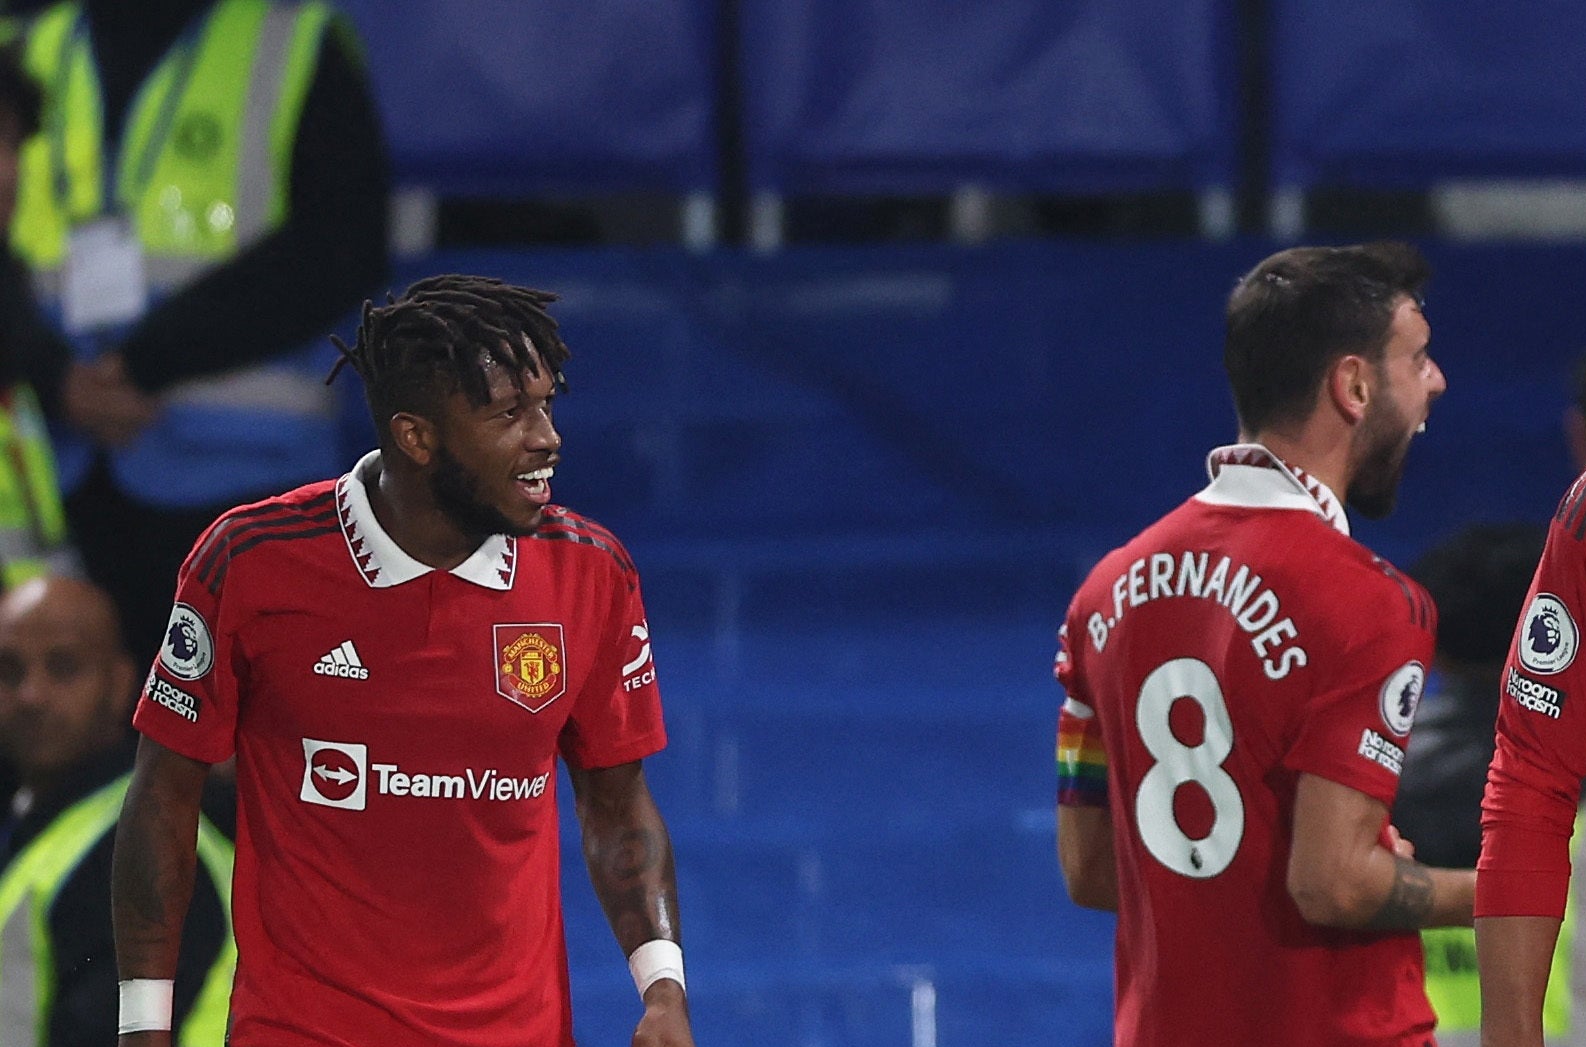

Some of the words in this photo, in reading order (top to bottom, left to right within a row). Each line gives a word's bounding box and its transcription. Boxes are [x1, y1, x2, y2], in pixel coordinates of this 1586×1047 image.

[1088, 551, 1307, 680] B.FERNANDES
[313, 662, 369, 680] adidas
[157, 680, 195, 708] room
[1517, 678, 1558, 704] room
[372, 763, 550, 801] TeamViewer
[1135, 657, 1245, 879] 8
